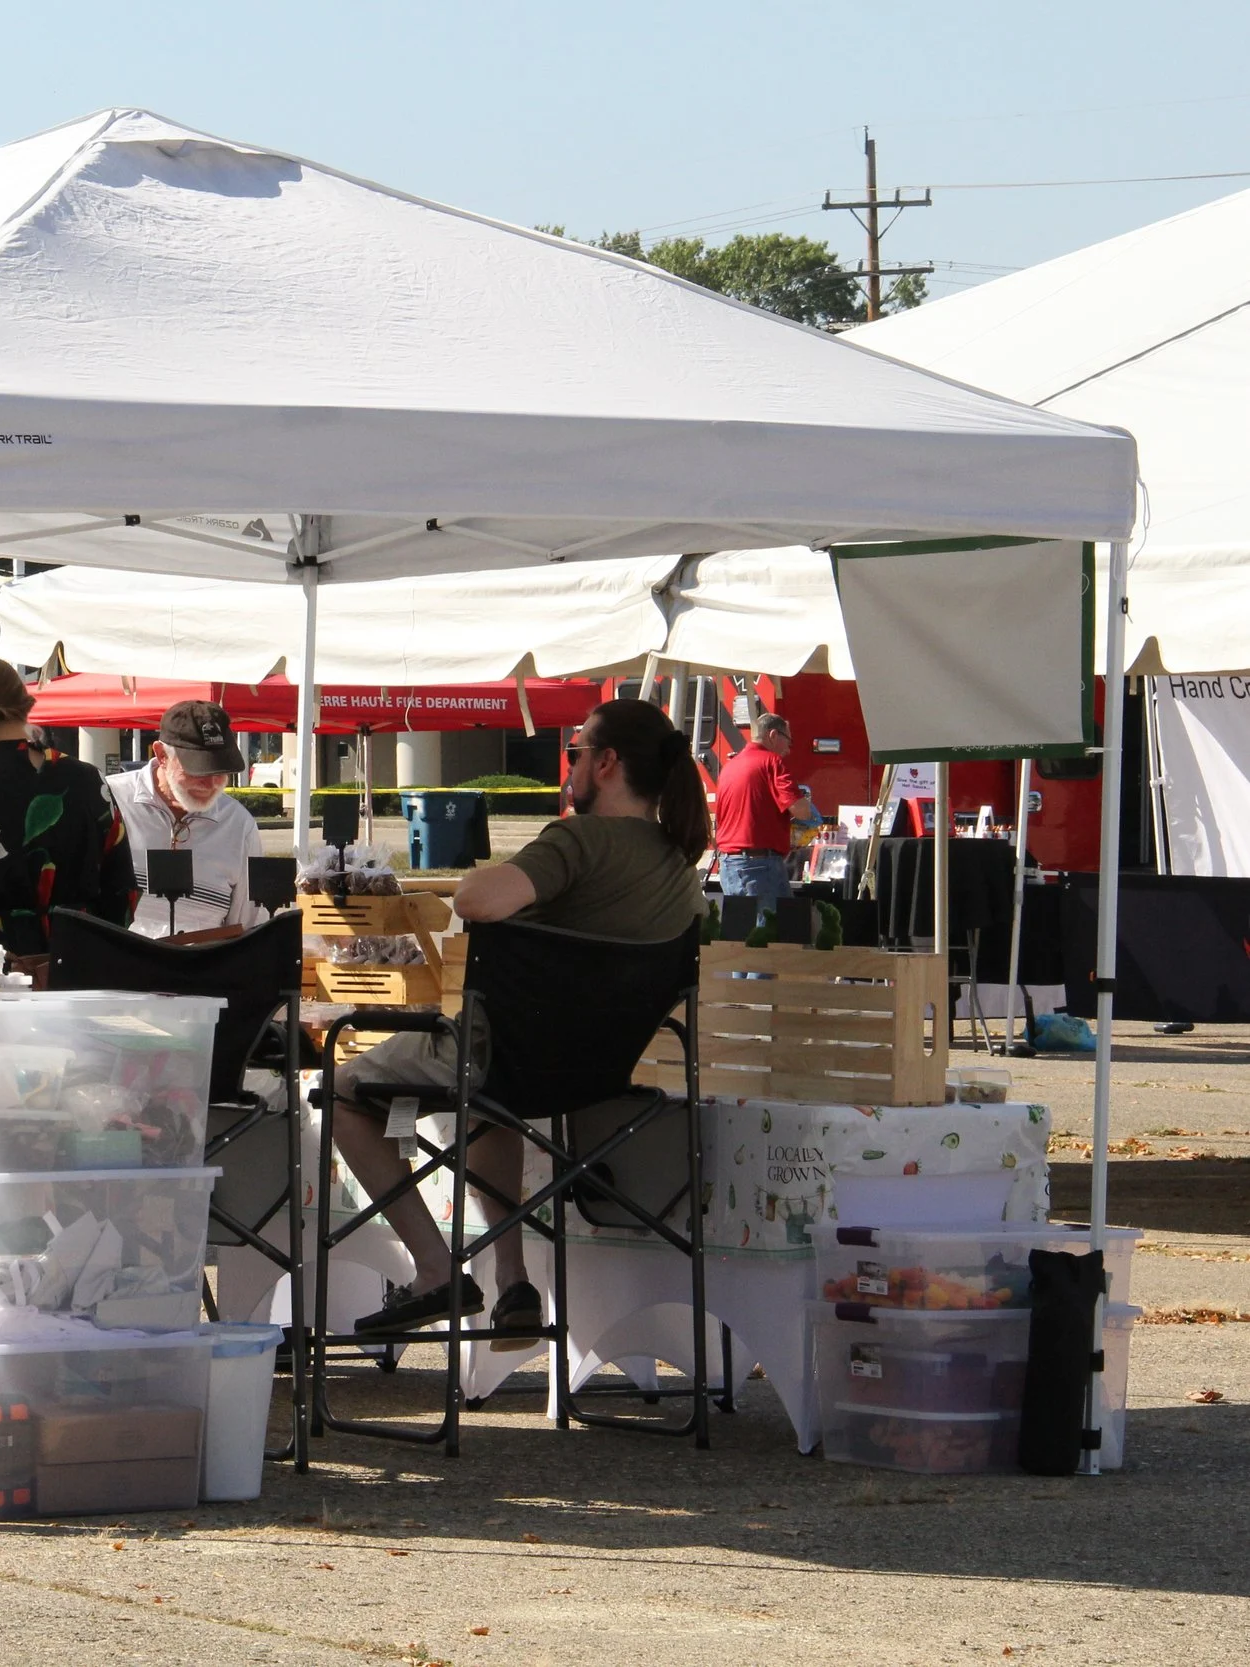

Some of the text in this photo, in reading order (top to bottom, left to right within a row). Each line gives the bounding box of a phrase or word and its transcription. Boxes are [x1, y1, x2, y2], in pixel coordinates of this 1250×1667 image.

[14, 434, 52, 444] TRAIL
[1169, 675, 1224, 699] Hand
[351, 696, 393, 708] HAUTE
[396, 696, 423, 708] FIRE
[426, 697, 508, 710] DEPARTMENT
[767, 1145, 824, 1163] LOCALLY
[767, 1165, 827, 1184] GROWN
